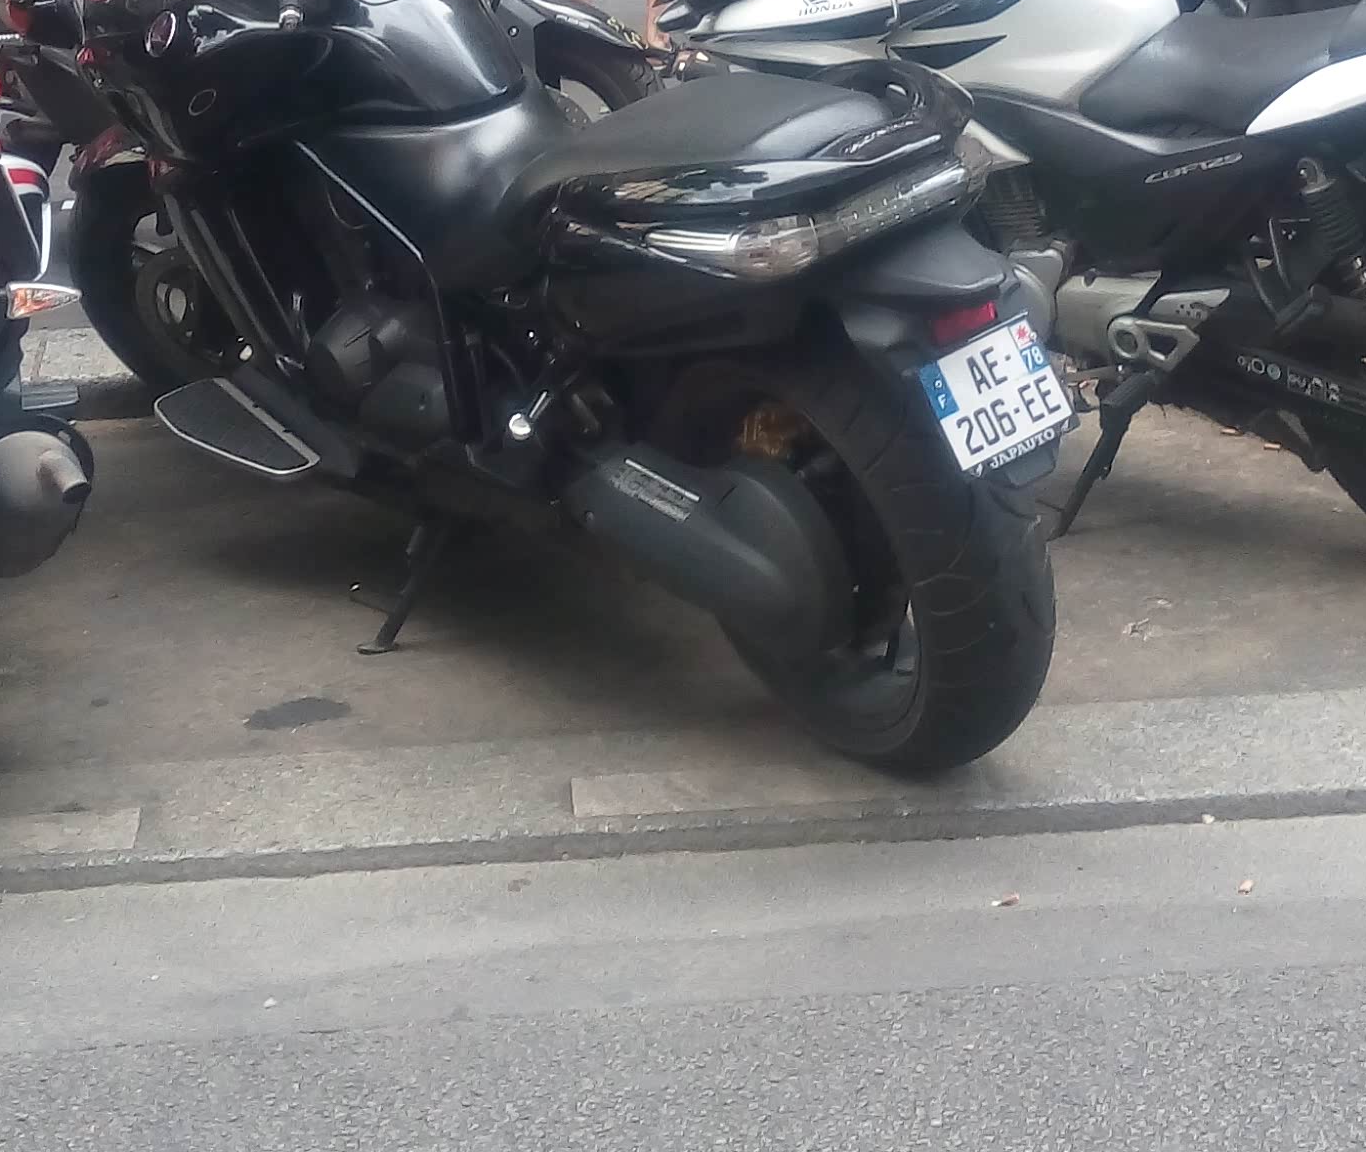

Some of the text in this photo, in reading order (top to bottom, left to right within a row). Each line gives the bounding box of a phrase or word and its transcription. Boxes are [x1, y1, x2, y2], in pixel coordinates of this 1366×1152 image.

[799, 1, 854, 17] HONDA
[1021, 345, 1045, 374] 78
[936, 393, 948, 410] F
[989, 427, 1056, 469] JAPAUTO
